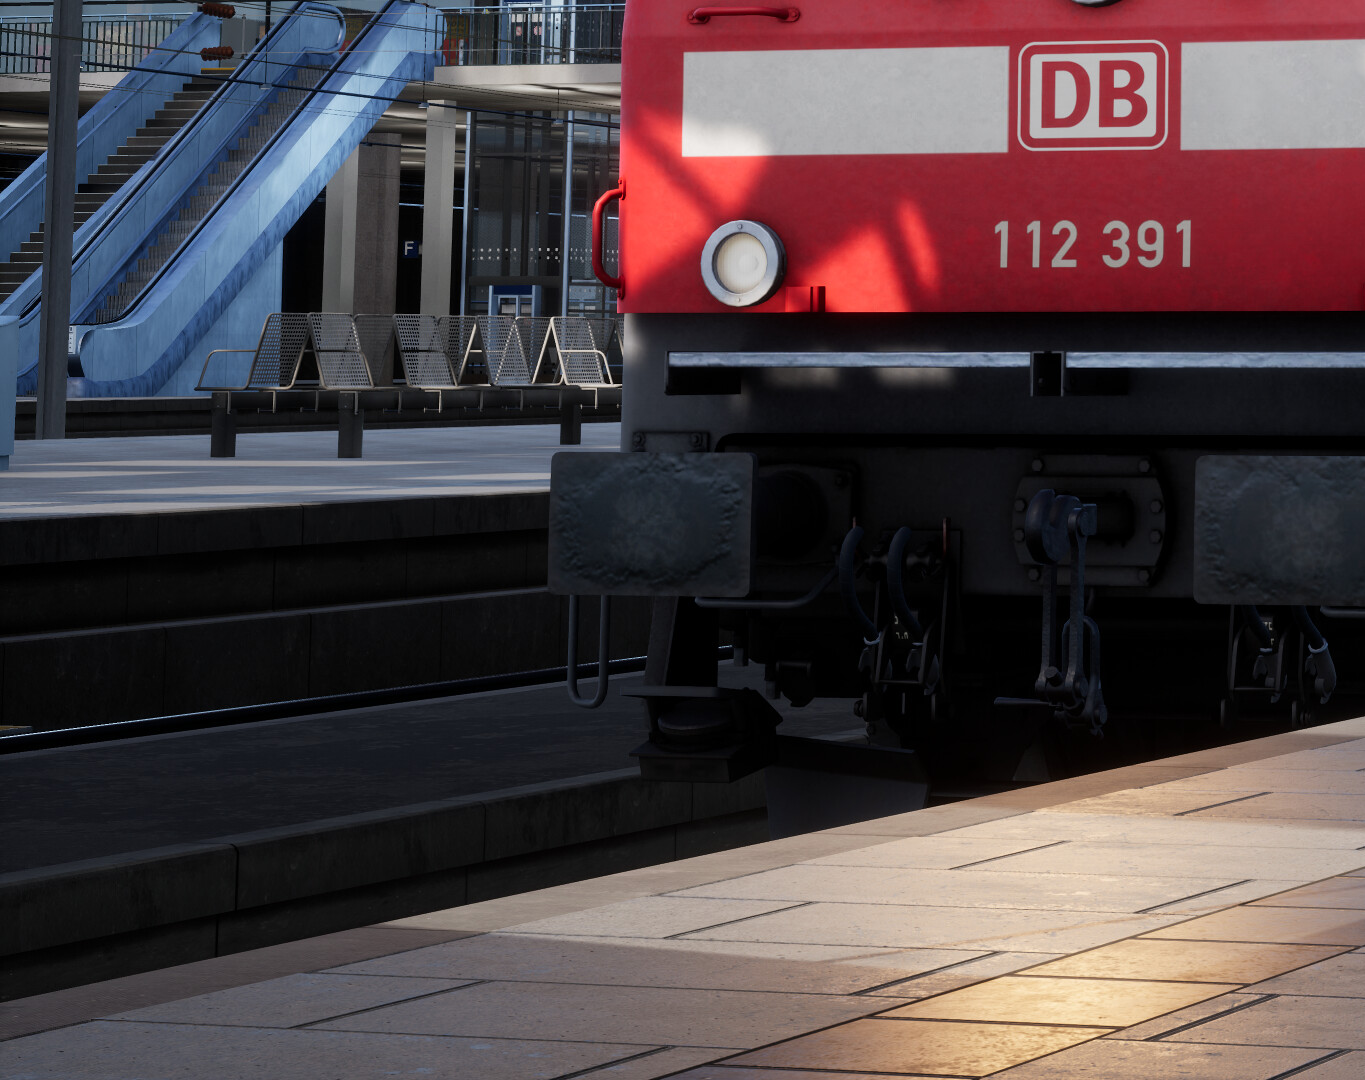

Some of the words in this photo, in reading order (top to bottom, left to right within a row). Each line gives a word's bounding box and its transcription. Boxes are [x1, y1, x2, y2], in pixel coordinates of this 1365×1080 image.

[1041, 59, 1148, 129] DB
[404, 240, 415, 256] F
[994, 220, 1078, 268] 112
[1102, 220, 1192, 268] 391
